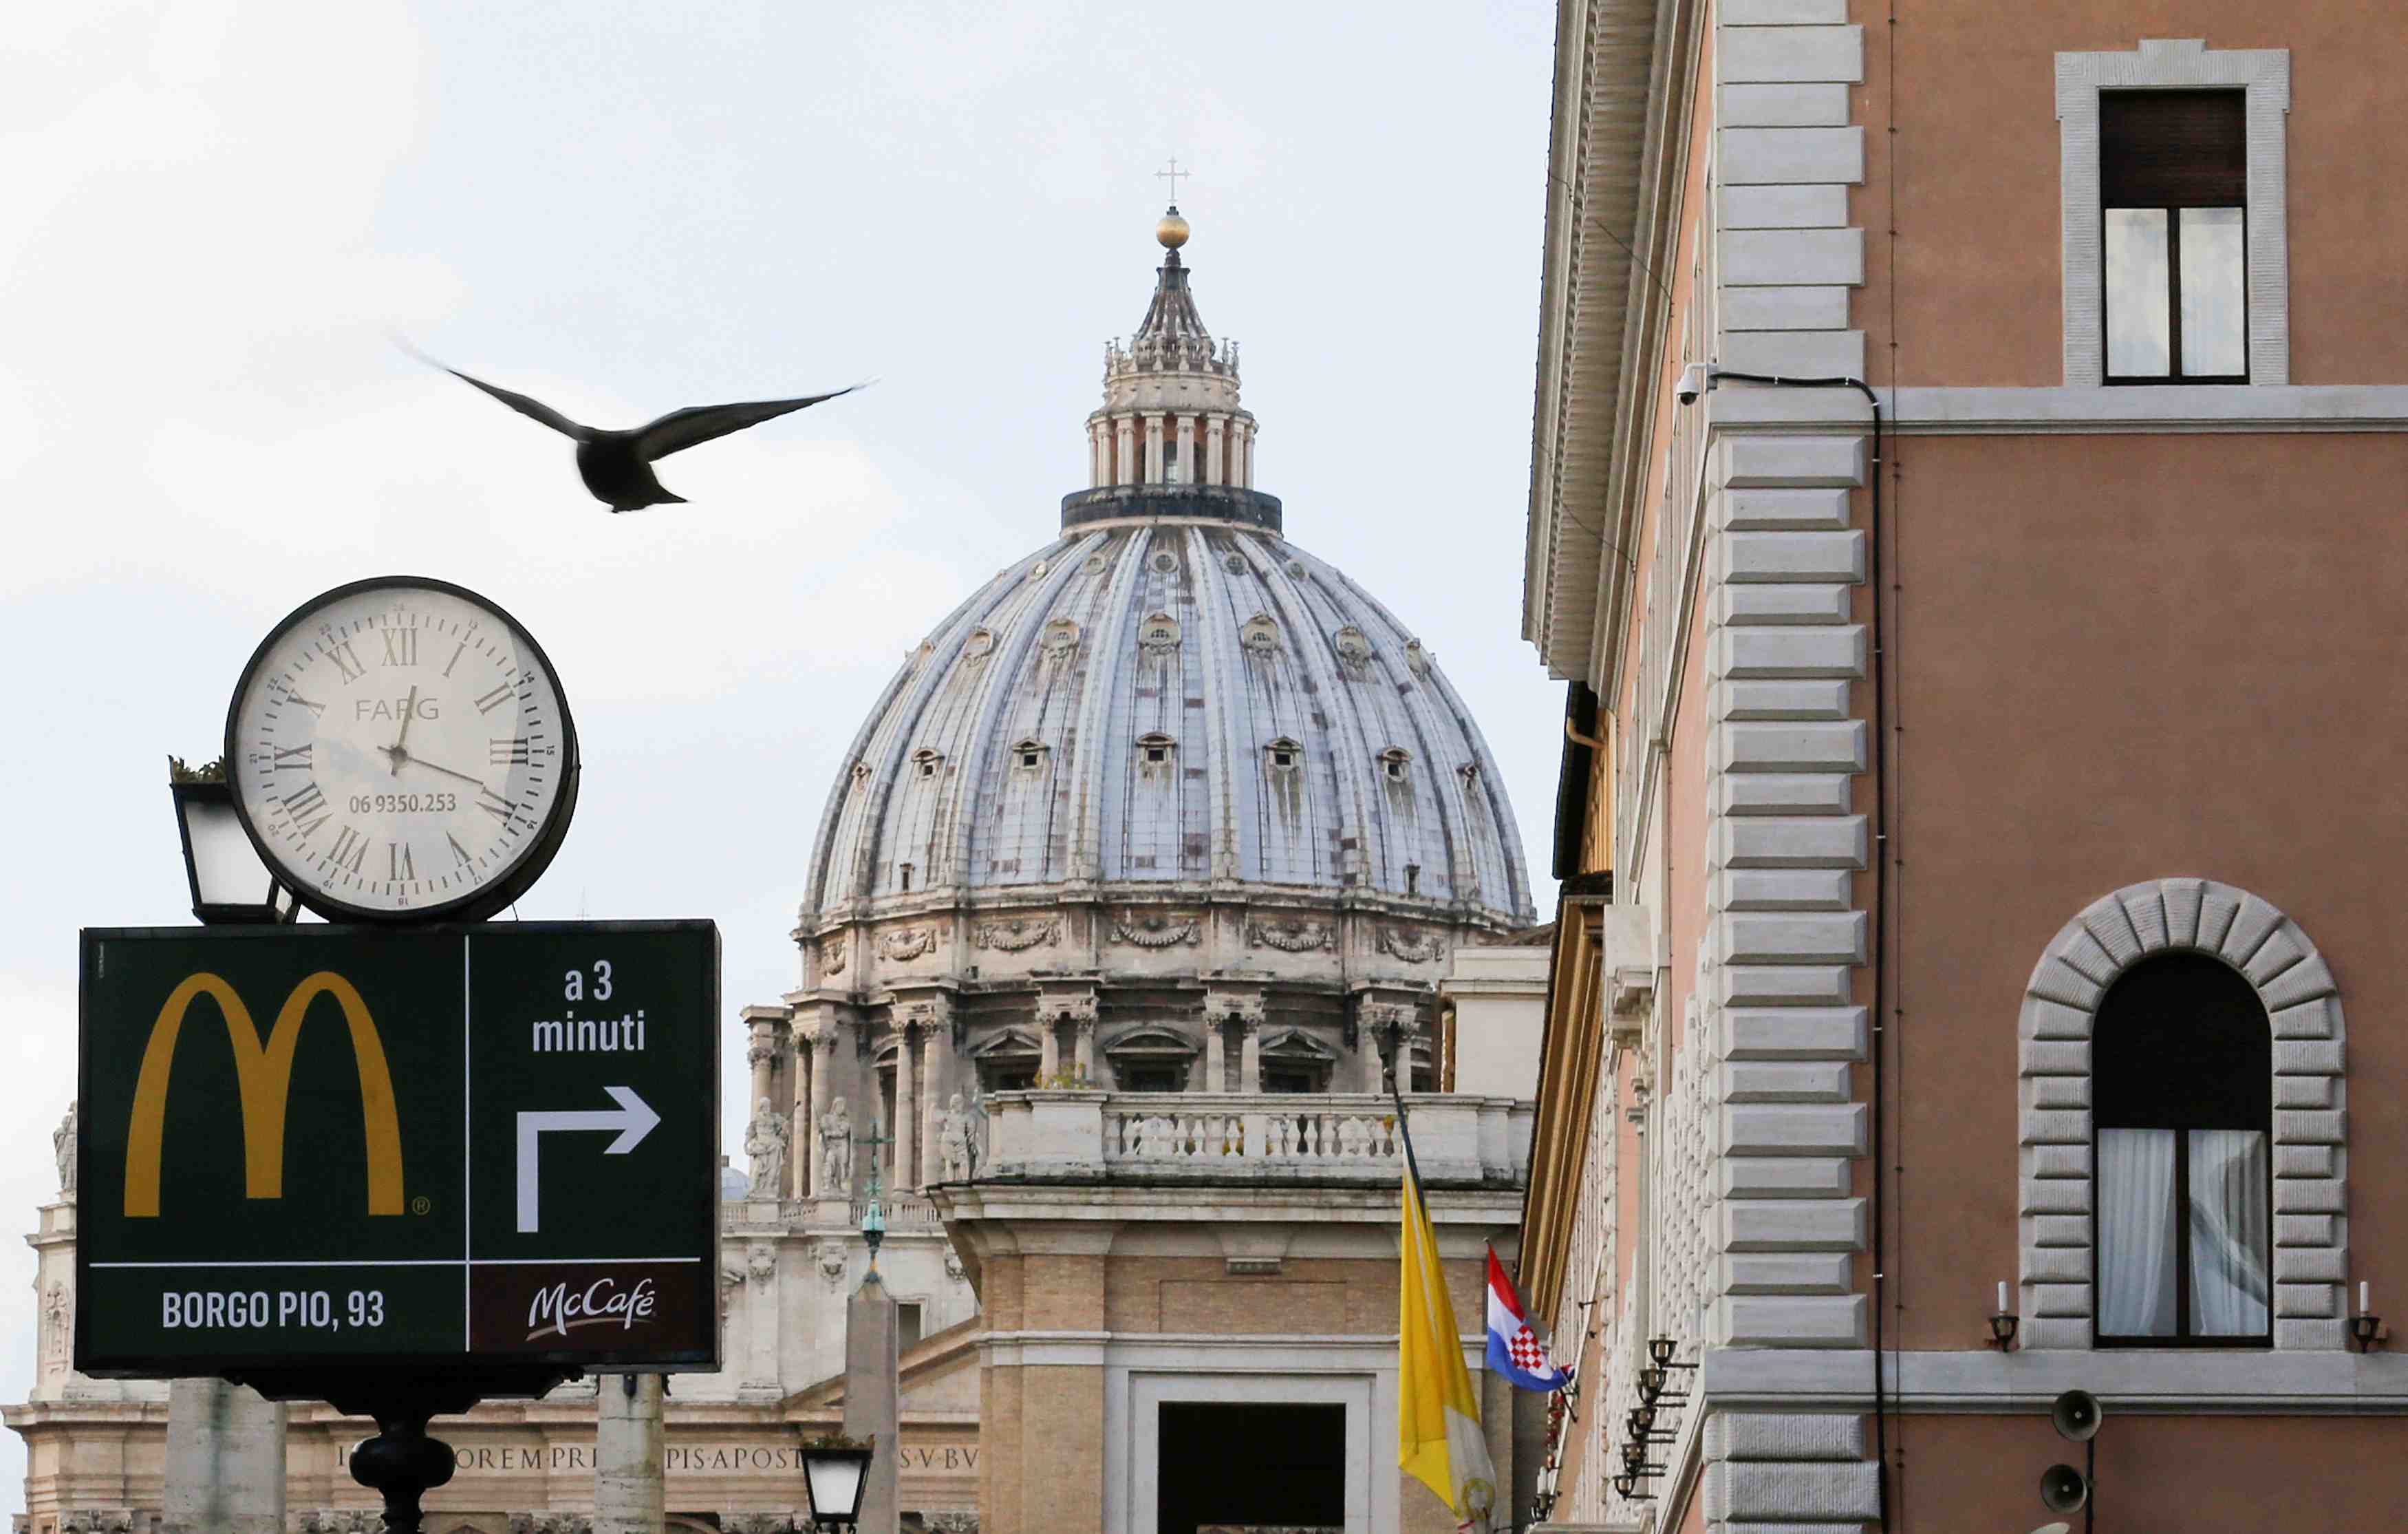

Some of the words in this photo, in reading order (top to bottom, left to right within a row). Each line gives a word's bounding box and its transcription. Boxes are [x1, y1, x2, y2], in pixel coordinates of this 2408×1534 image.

[325, 641, 367, 684] XI
[381, 628, 418, 666] XII
[442, 642, 466, 678] I
[267, 677, 279, 690] 22
[524, 671, 535, 683] 14
[286, 689, 326, 718] X
[474, 683, 515, 715] II
[274, 743, 312, 771] IX
[490, 738, 528, 765] III
[546, 745, 555, 756] 15
[475, 787, 518, 827] IV
[446, 831, 473, 867] V
[565, 970, 583, 1001] a
[593, 959, 612, 1001] 3
[533, 1010, 645, 1052] minuti
[162, 1291, 269, 1328] BORGO
[279, 1290, 338, 1332] PIO,
[347, 1290, 384, 1327] 93
[528, 1277, 656, 1336] McCafé
[455, 1448, 542, 1469] OREM
